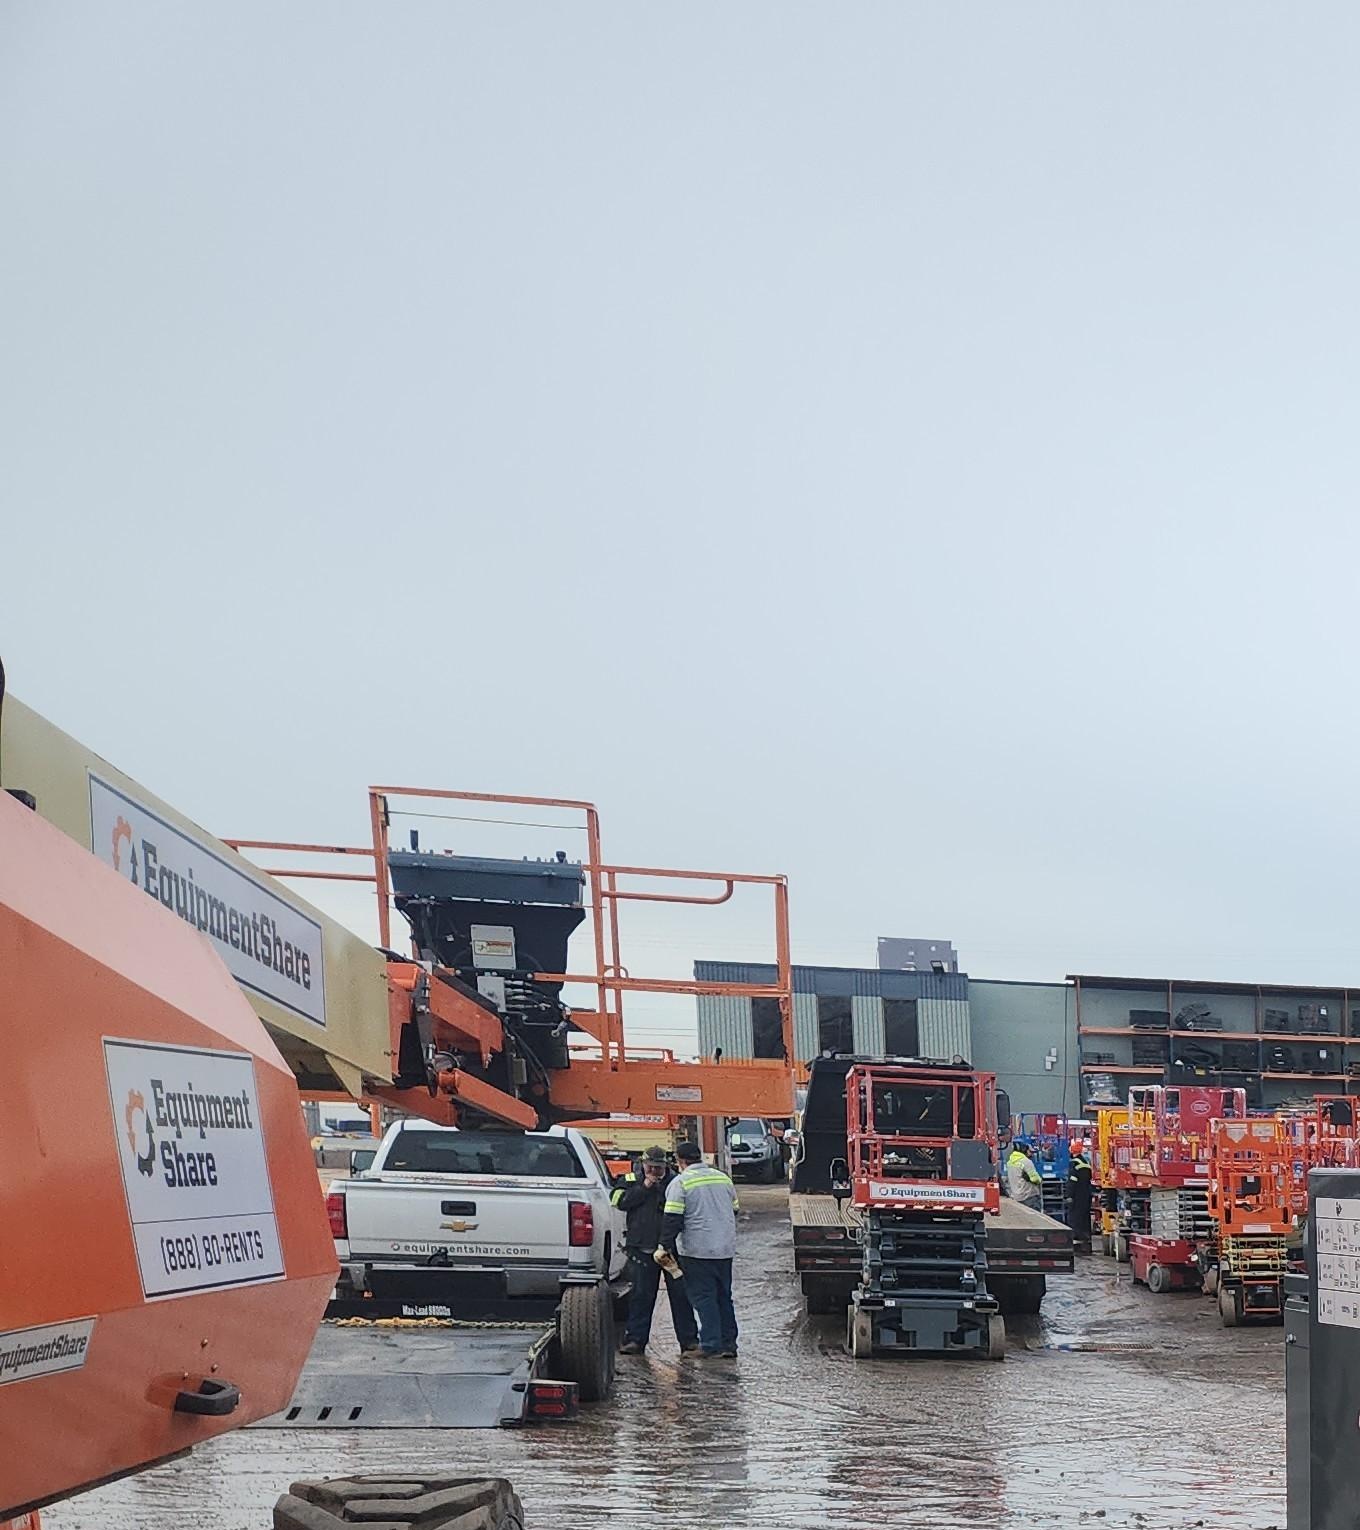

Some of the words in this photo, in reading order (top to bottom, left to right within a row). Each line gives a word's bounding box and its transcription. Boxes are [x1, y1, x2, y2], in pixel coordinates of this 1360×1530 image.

[150, 1078, 252, 1141] Equipment
[161, 1139, 218, 1188] Share
[891, 1188, 976, 1198] EquipmentShare
[161, 1236, 201, 1276] (888)
[204, 1229, 265, 1267] 80-RENTS
[0, 1334, 88, 1375] quipmentShare
